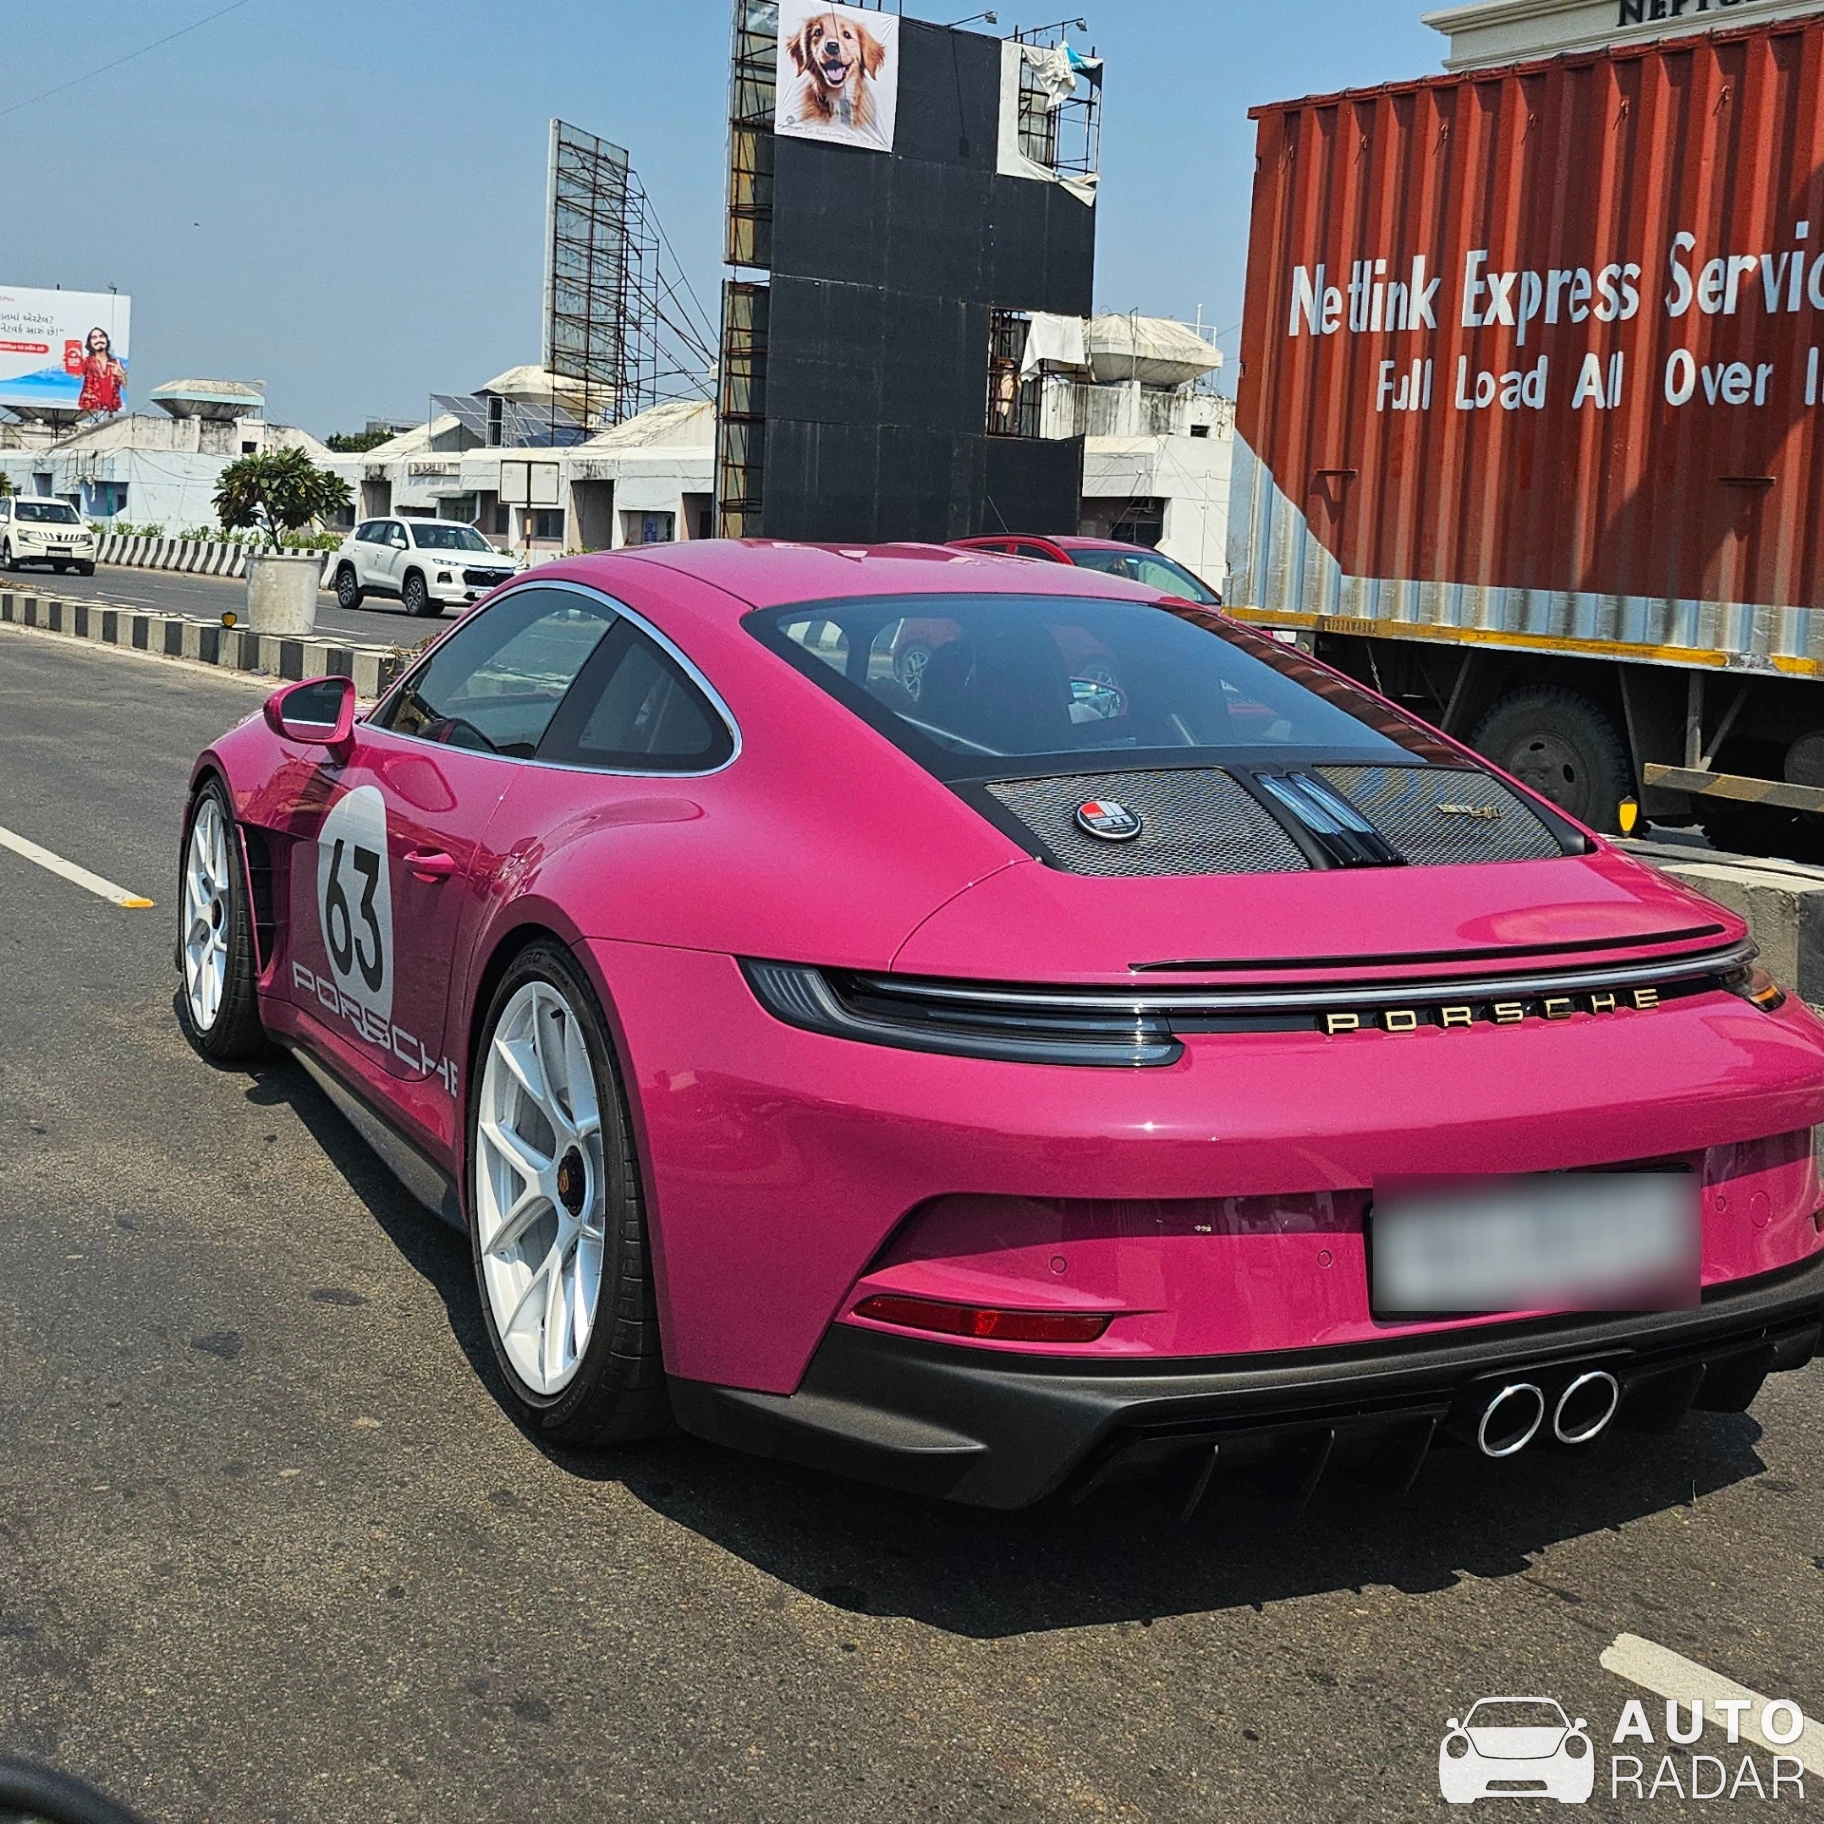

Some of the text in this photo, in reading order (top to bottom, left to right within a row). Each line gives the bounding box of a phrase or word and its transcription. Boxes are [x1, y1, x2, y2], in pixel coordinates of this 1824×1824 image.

[1288, 254, 1441, 336] Netlink
[1461, 249, 1641, 346] Express
[1376, 358, 1433, 412] Full
[1455, 354, 1549, 411] Load
[1571, 350, 1624, 410] All
[1665, 347, 1773, 407] Over
[325, 838, 383, 994] 63
[292, 961, 458, 1098] PORSCHE
[1326, 988, 1660, 1035] PORSCHE
